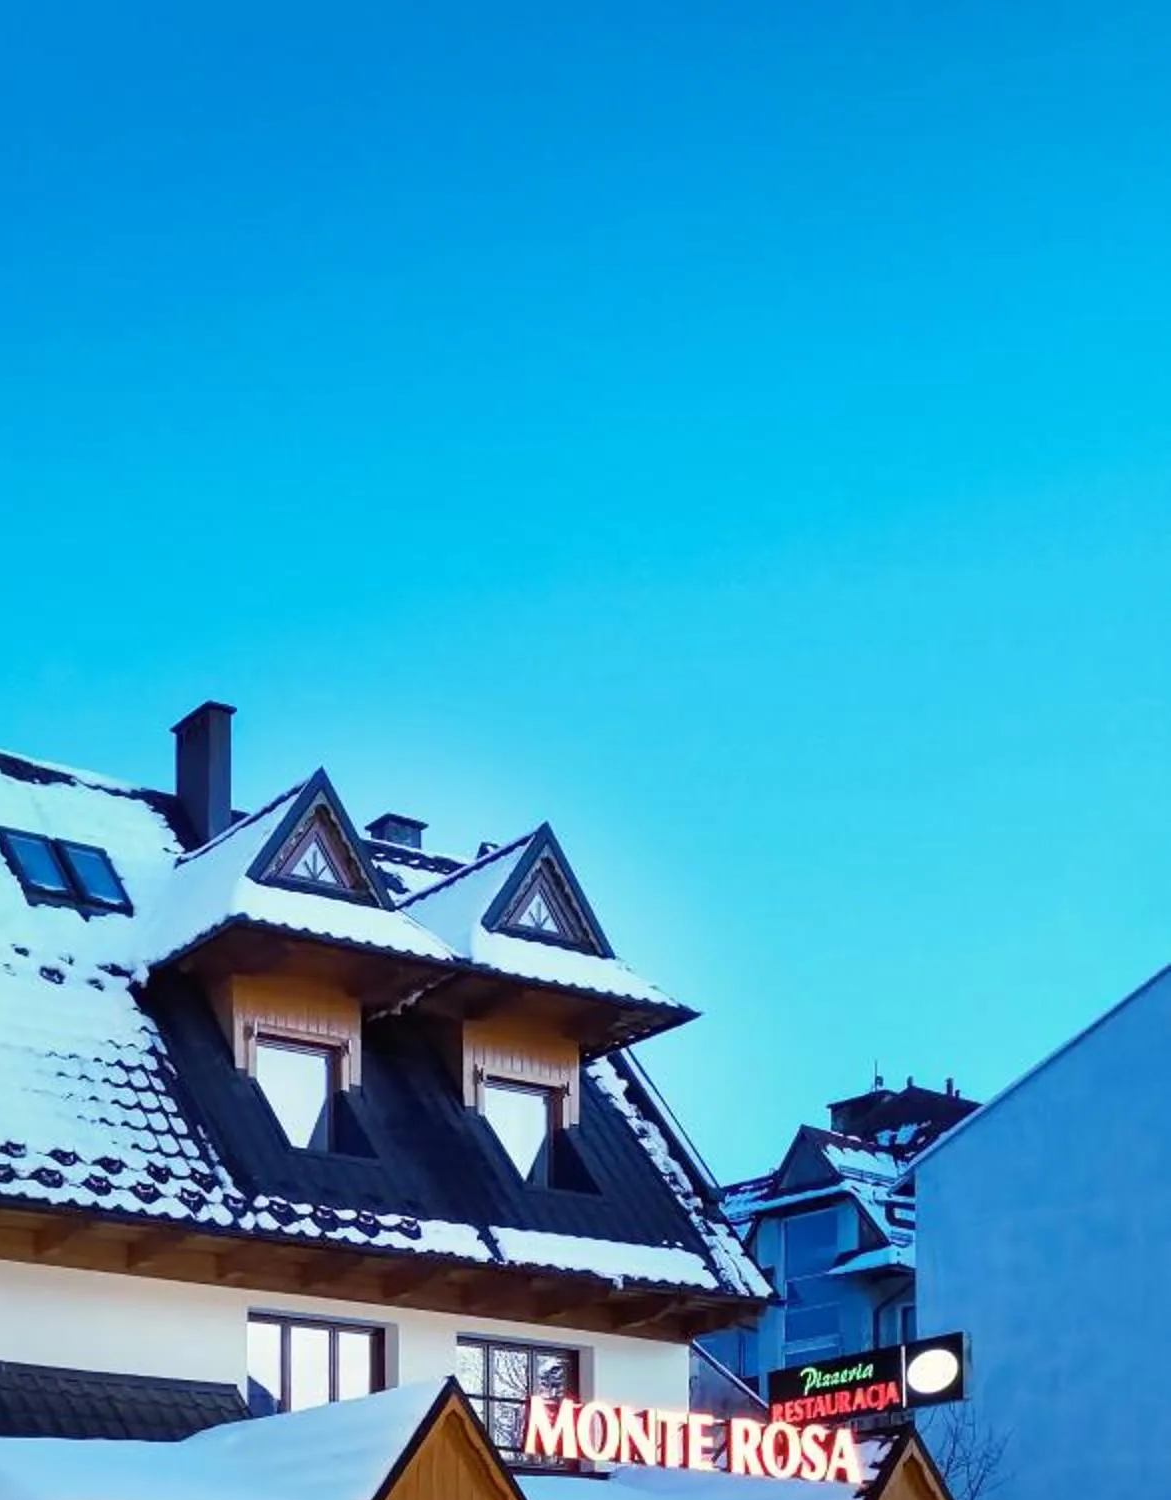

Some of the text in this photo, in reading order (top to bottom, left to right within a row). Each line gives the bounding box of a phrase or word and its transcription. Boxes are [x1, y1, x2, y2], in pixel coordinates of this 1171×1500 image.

[800, 1363, 875, 1396] Pizzeria
[772, 1381, 900, 1424] RESTAURACJA
[524, 1395, 863, 1485] MONTE ROSA
